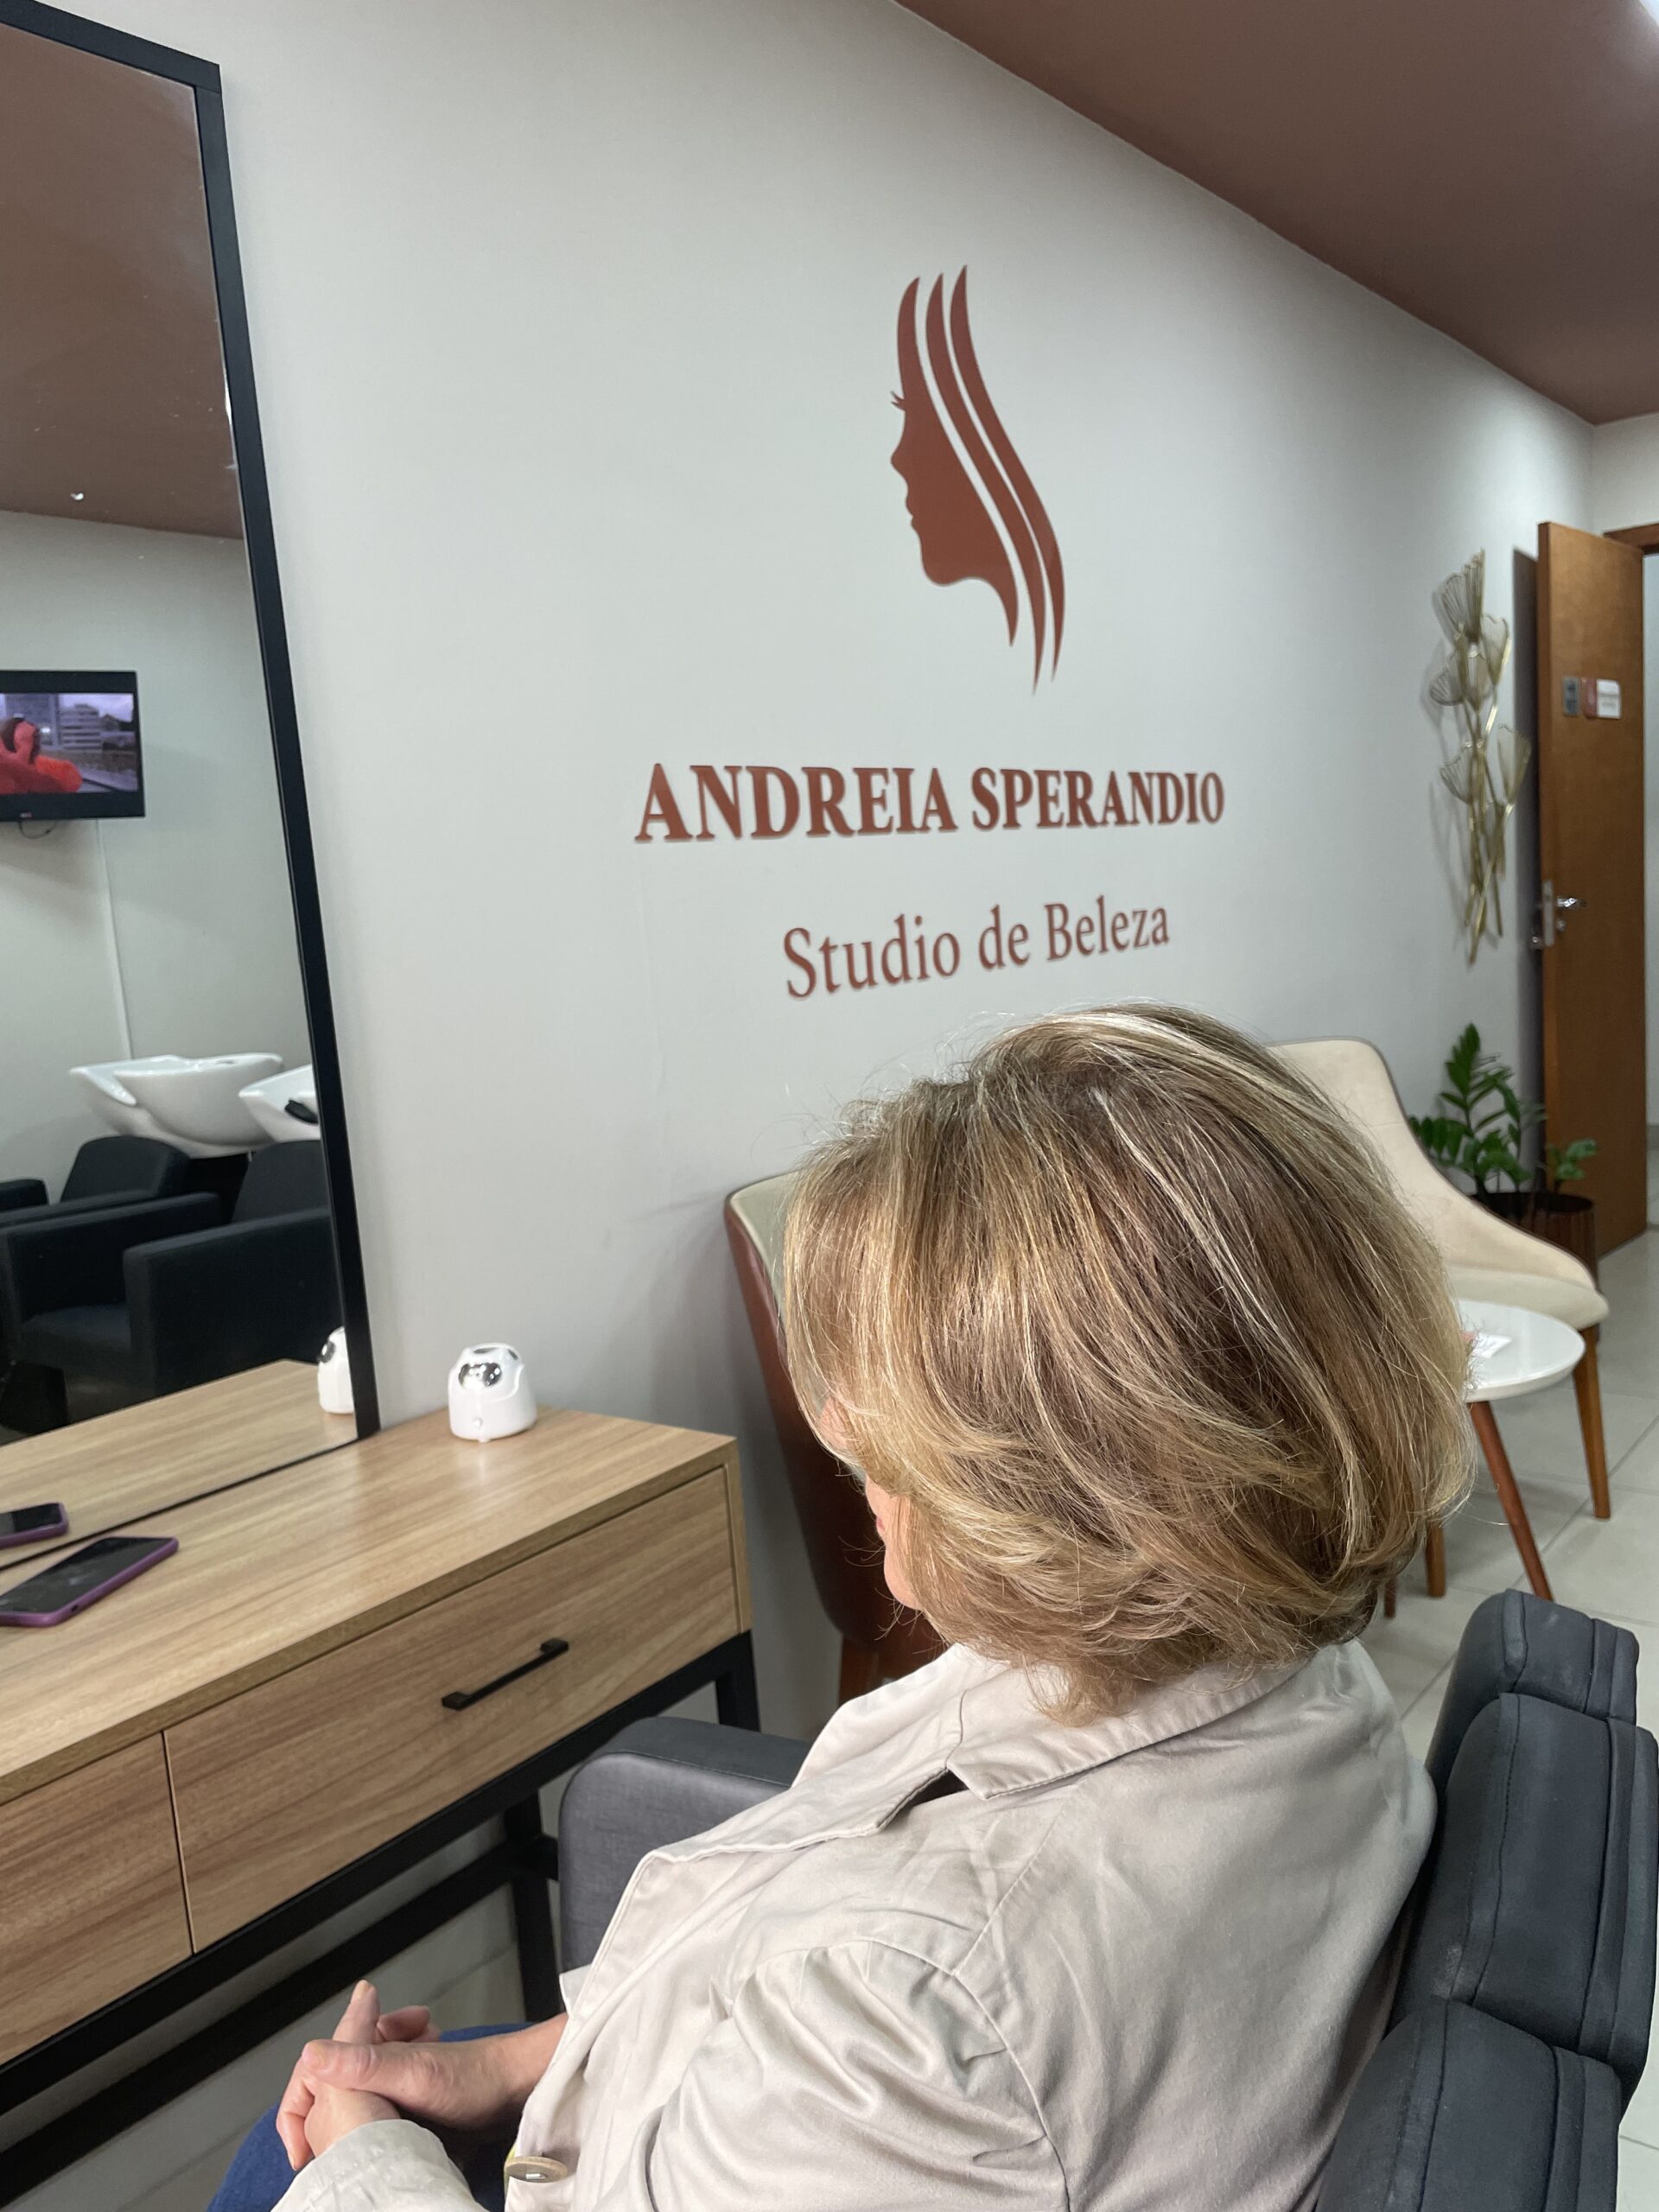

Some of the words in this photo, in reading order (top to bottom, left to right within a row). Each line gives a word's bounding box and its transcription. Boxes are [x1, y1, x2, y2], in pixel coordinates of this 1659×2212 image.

[634, 762, 959, 843] ANDREIA
[970, 766, 1225, 831] SPERANDIO
[783, 913, 961, 1000] Studio
[978, 905, 1031, 971] de
[1046, 895, 1170, 961] Beleza
